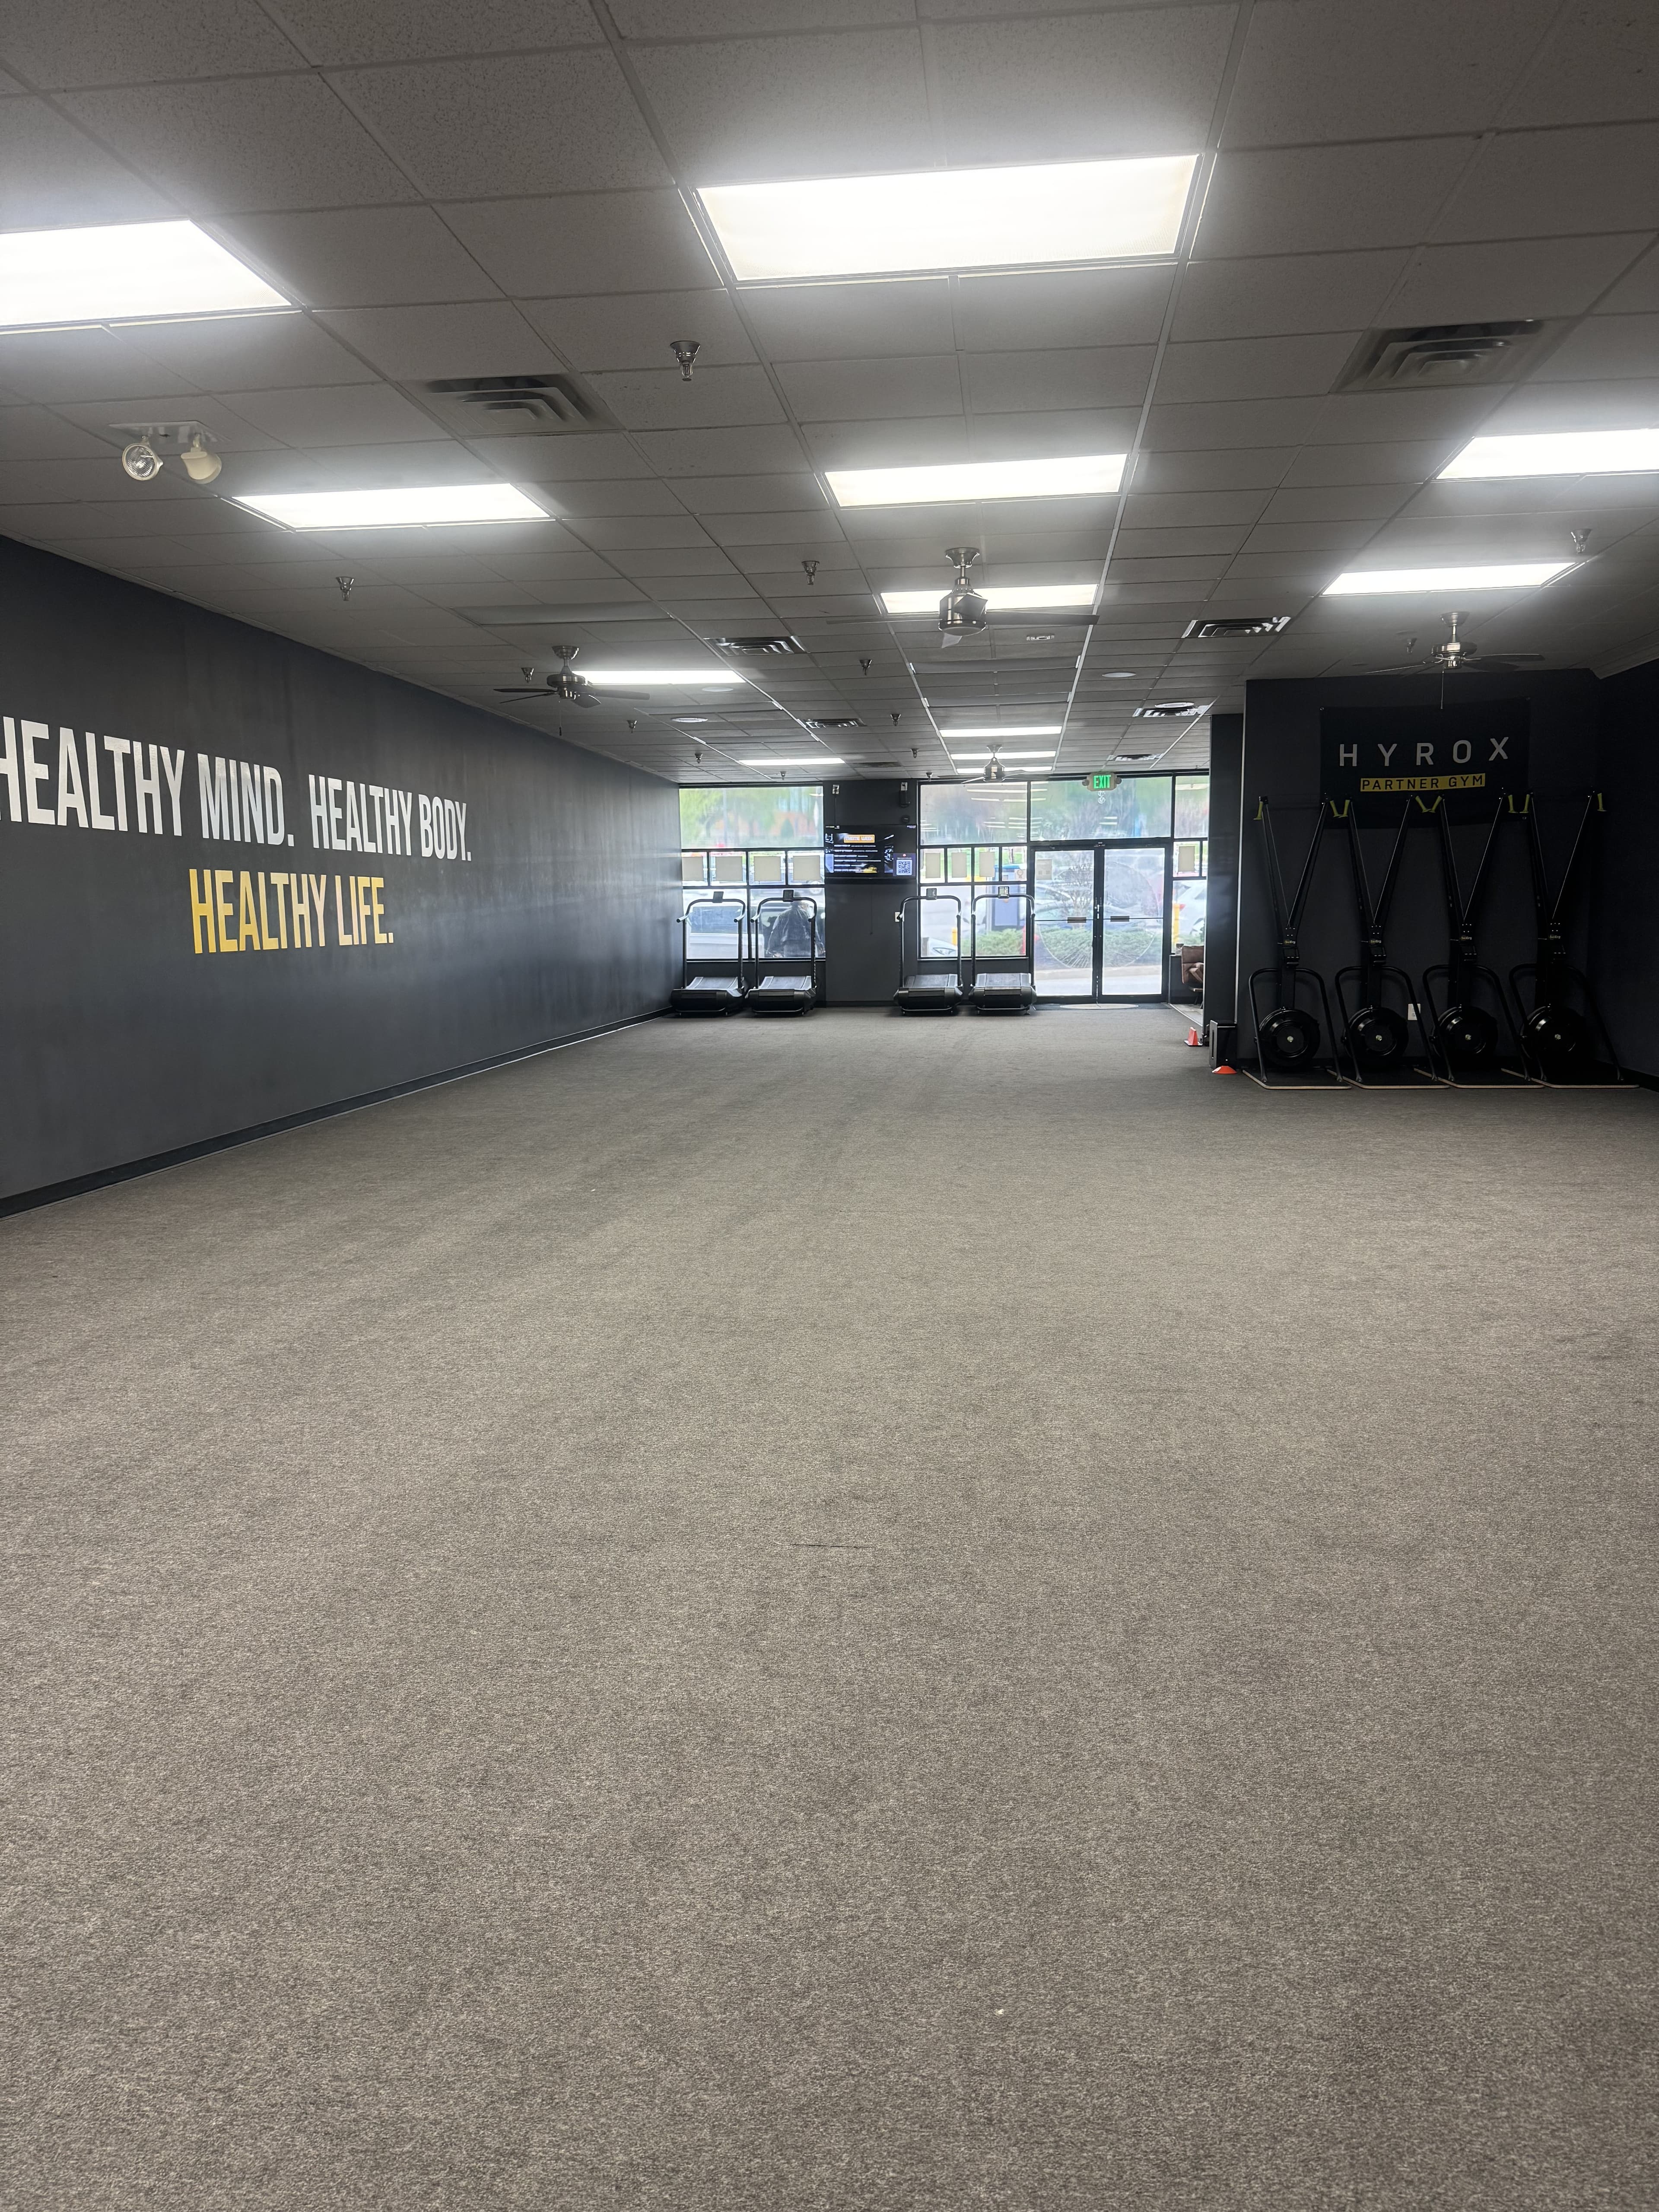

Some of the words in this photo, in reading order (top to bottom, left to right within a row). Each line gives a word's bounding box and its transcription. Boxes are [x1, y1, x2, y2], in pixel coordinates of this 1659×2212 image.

[1339, 737, 1509, 767] HYROX
[0, 716, 185, 836] HEALTHY
[197, 753, 294, 847] MIND.
[308, 774, 412, 856] HEALTHY
[418, 794, 472, 861] BODY.
[1093, 775, 1111, 788] EXIT
[1362, 779, 1439, 790] PARTNER
[1449, 775, 1482, 787] GYM
[189, 869, 327, 954] HEALTHY
[335, 875, 394, 946] LIFE.
